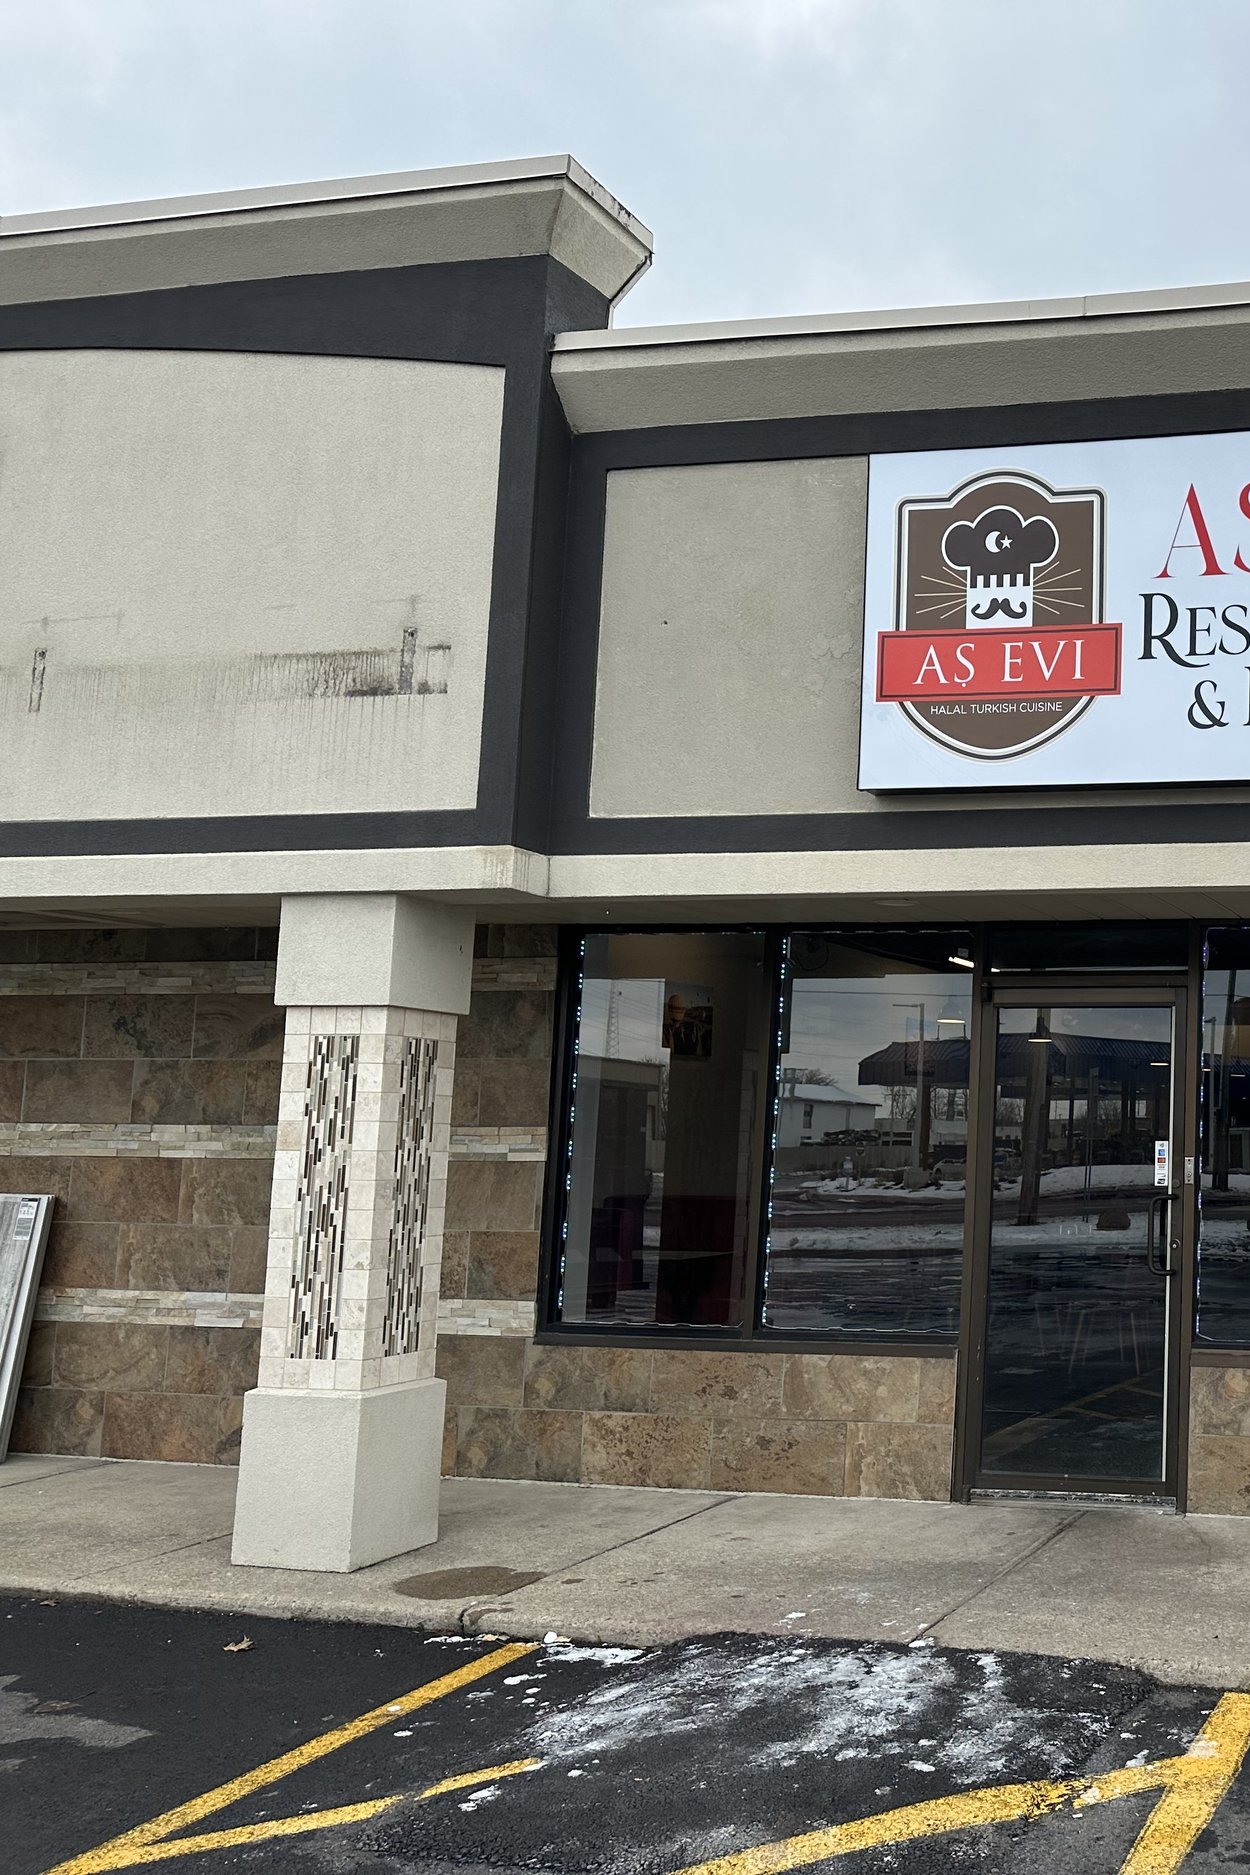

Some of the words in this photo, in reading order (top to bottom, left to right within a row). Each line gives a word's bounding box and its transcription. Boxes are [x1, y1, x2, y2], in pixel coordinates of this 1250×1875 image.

[1001, 639, 1086, 682] EVI
[930, 704, 968, 716] HALAL
[970, 702, 1017, 715] TURKISH
[1019, 701, 1064, 714] CUISINE
[1187, 679, 1231, 730] &
